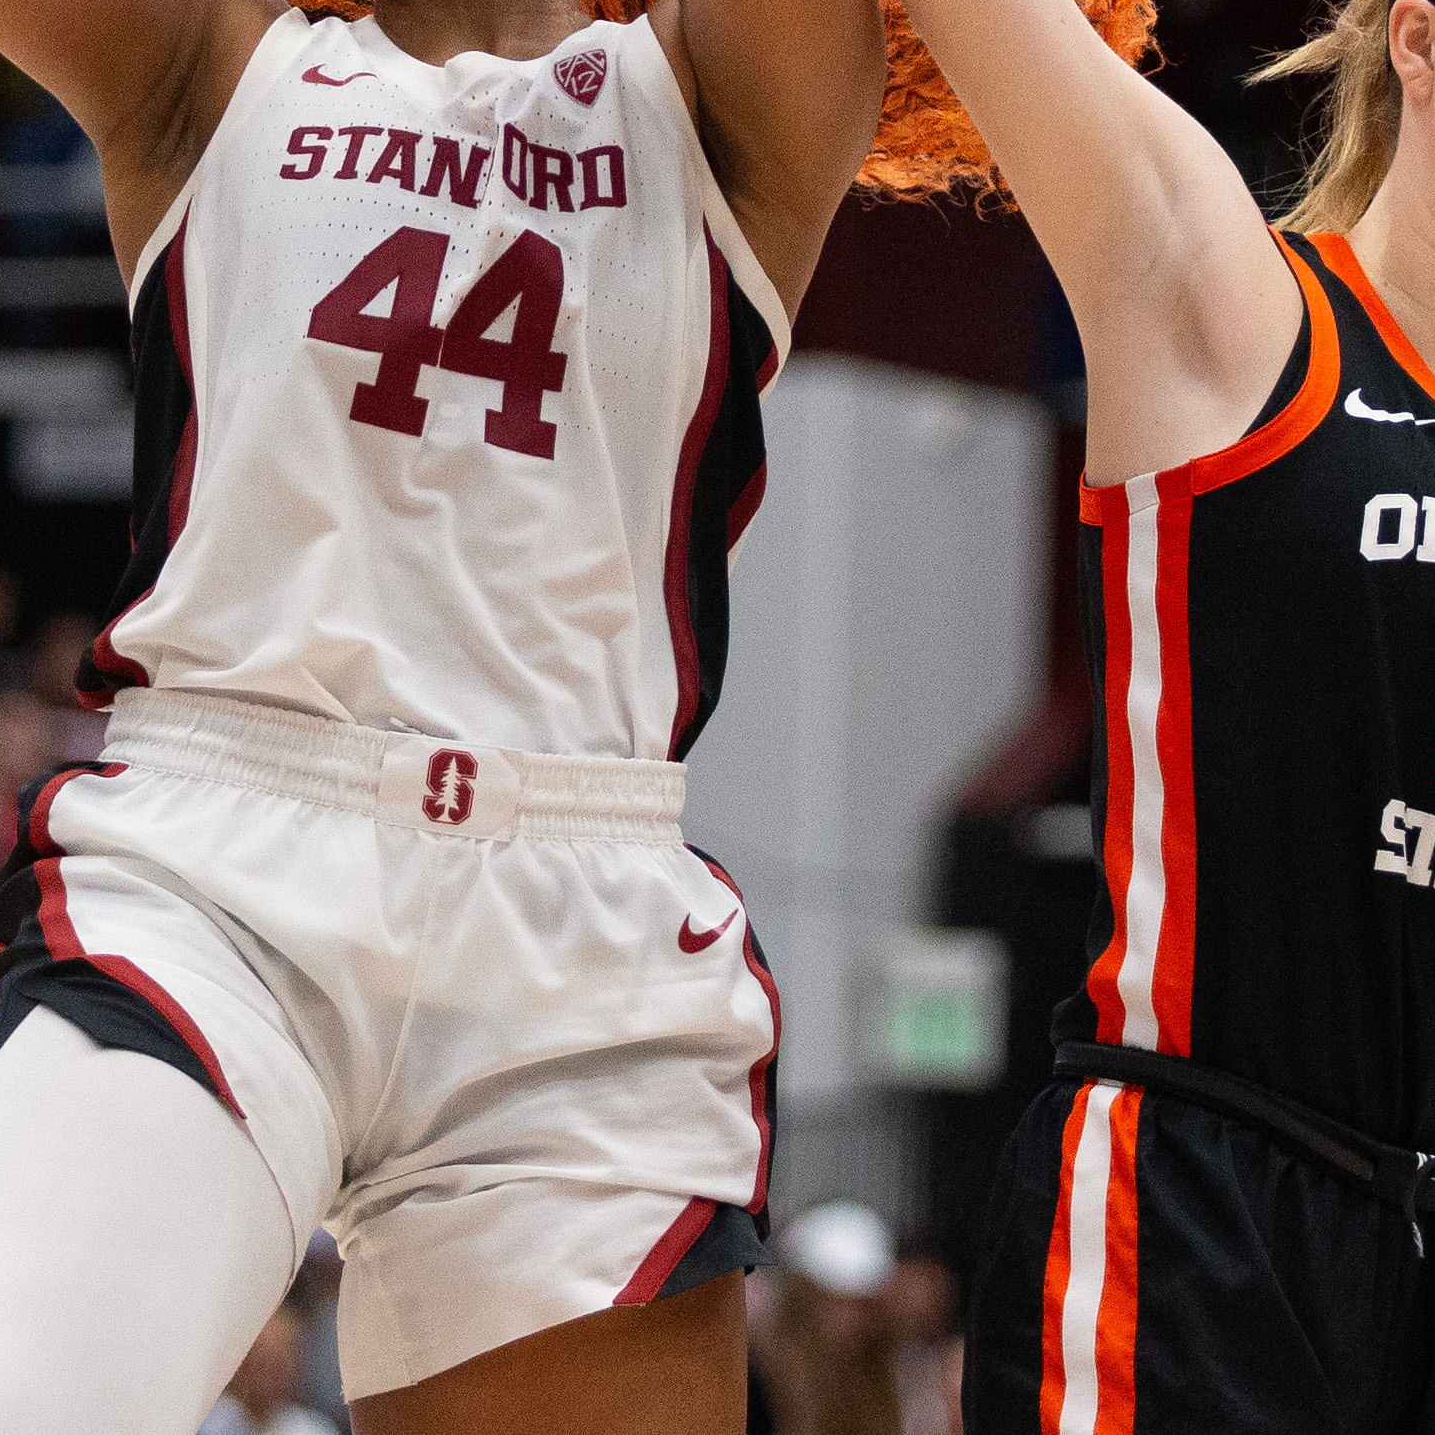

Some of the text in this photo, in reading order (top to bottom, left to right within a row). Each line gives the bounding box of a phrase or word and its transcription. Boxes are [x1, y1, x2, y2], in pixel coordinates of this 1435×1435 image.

[571, 70, 600, 96] 12
[280, 123, 628, 213] STANORD
[307, 225, 567, 460] 44
